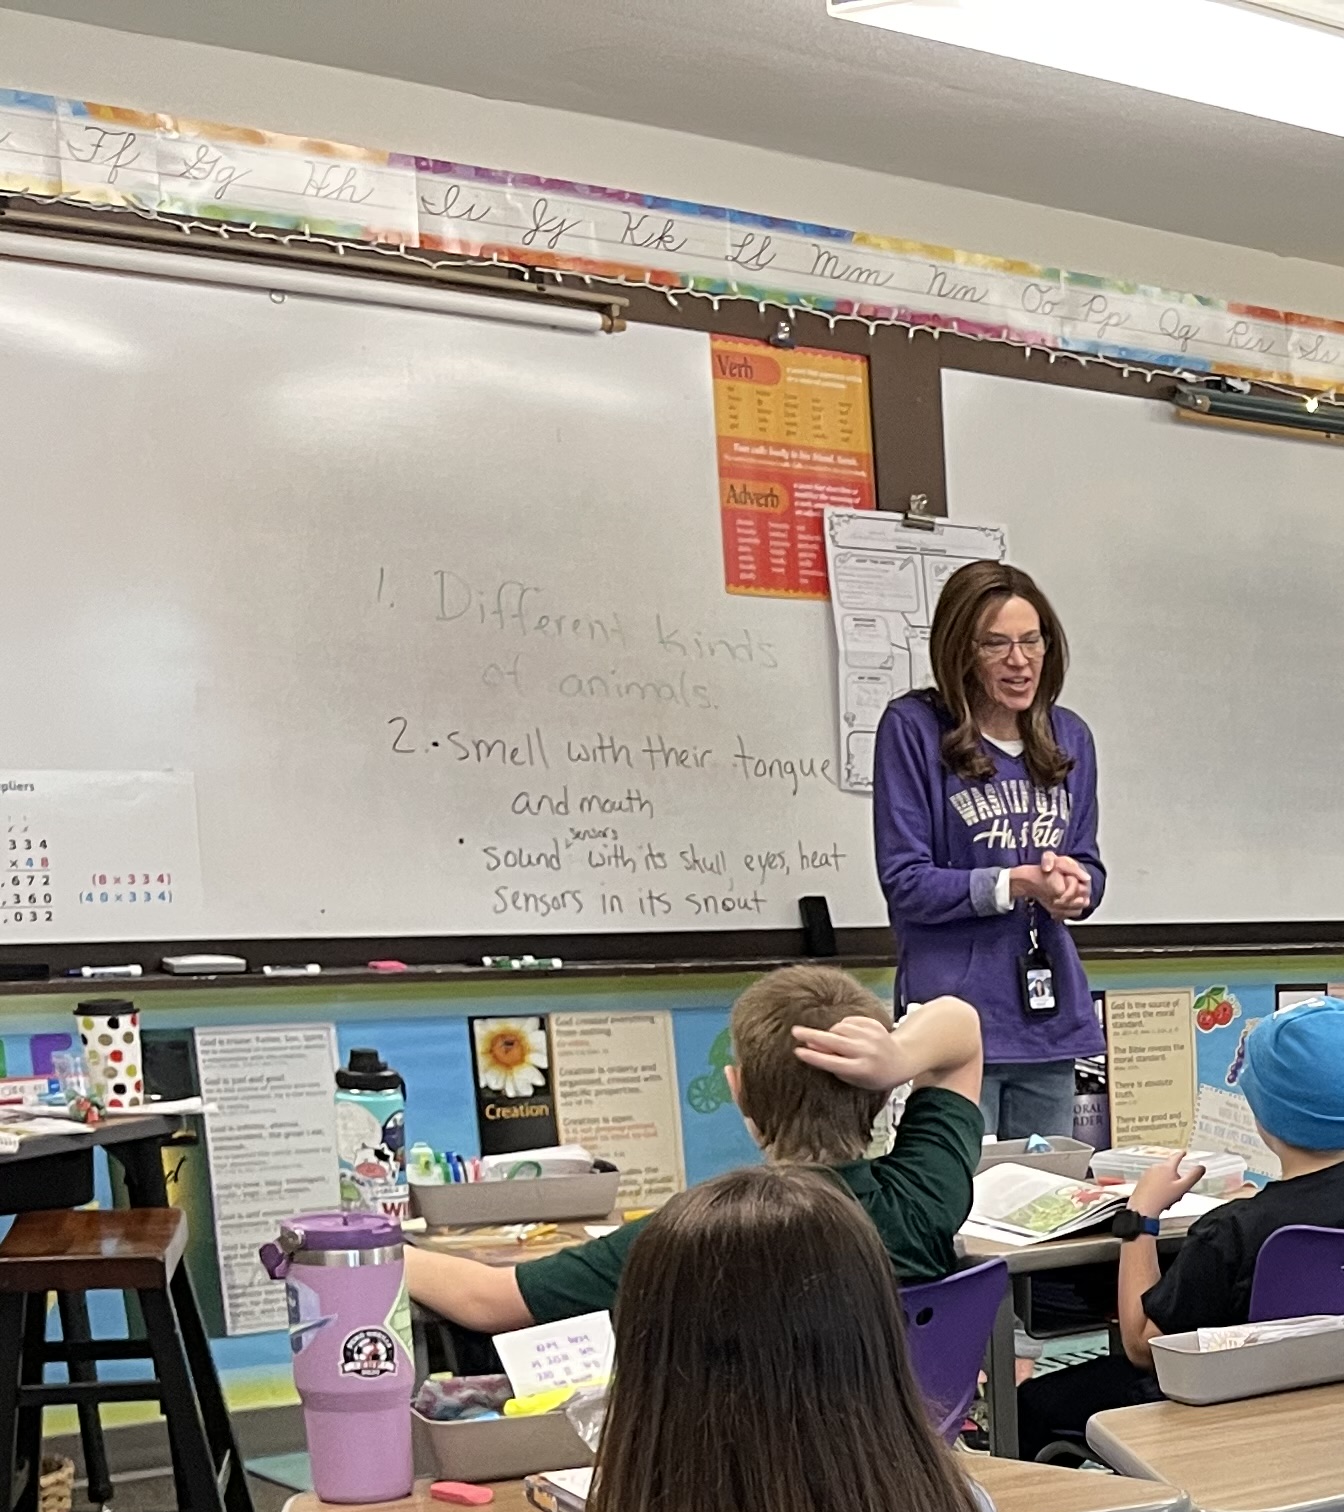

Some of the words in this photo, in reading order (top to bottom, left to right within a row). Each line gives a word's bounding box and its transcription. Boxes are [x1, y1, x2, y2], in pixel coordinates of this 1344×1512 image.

[67, 126, 140, 184] Ff
[176, 144, 253, 199] Gg
[303, 159, 375, 205] Hh
[524, 200, 585, 249] Jj
[619, 211, 691, 253] Kk
[724, 232, 776, 271] Ll
[812, 244, 895, 288] Mm
[926, 264, 988, 304] Nn
[1022, 281, 1061, 315] Oo
[1081, 293, 1130, 327] Pp
[1158, 307, 1202, 343] Qq
[1226, 320, 1275, 354] Rr
[716, 355, 753, 379] Verb
[727, 484, 779, 508] Adverb
[435, 570, 627, 642] Different
[482, 663, 523, 688] of
[567, 733, 632, 765] with
[643, 732, 713, 771] their
[735, 737, 836, 795] tongue
[512, 788, 569, 815] and
[579, 788, 655, 819] mouth
[568, 827, 618, 841] sensors
[485, 838, 561, 870] sound
[587, 846, 636, 870] with
[639, 847, 668, 869] its
[799, 845, 846, 873] heat
[493, 887, 585, 915] sensors
[601, 891, 625, 913] in
[639, 887, 671, 915] its
[687, 890, 768, 915] snout
[1111, 1001, 1125, 1009] God
[1128, 1001, 1133, 1009] is
[1173, 999, 1179, 1008] of
[1112, 1011, 1125, 1019] and
[1114, 1046, 1126, 1054] The
[1114, 1056, 1133, 1064] moral
[1115, 1080, 1134, 1088] There
[485, 1102, 549, 1120] Creation
[1074, 1104, 1102, 1113] ORAL
[1074, 1115, 1103, 1126] RDER
[1116, 1116, 1135, 1125] There
[1151, 1113, 1167, 1122] good
[1116, 1124, 1130, 1132] bad
